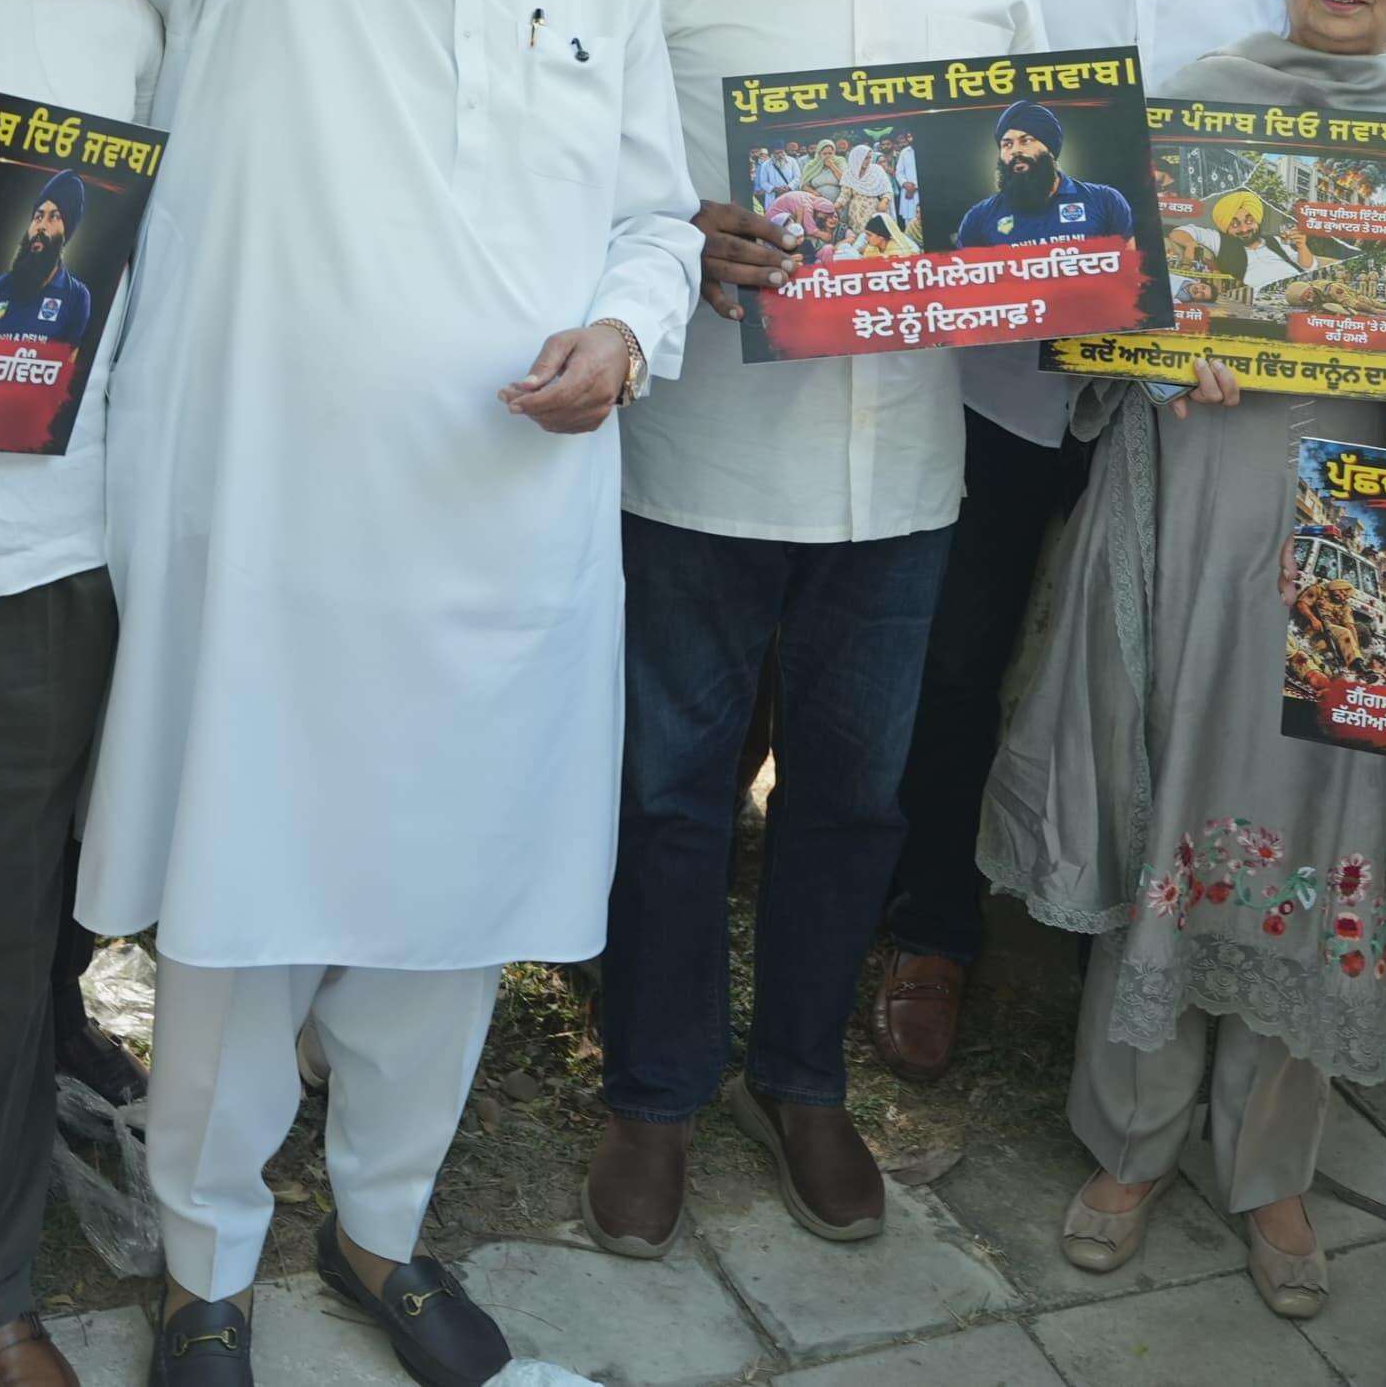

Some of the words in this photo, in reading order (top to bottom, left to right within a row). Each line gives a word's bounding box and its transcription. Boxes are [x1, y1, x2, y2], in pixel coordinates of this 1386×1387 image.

[732, 80, 827, 122] ਪੁੱਛਦਾ
[841, 70, 934, 106] ਪੰਜਾਬ
[945, 60, 1015, 101] ਦਿਓ
[1026, 58, 1136, 92] ਜਵਾਬ।
[23, 108, 80, 158] ਦਿਓ
[83, 132, 161, 177] ਜਵਾਬ।
[1183, 103, 1254, 134] ਪੰਜਾਬ
[1265, 108, 1319, 140] ਦਿਓ
[866, 261, 911, 292] ਕਦੋਂ
[914, 257, 1004, 289] ਮਿਲੇਗਾ
[1009, 248, 1120, 278] ਪਰਵਿੰਦਰ
[852, 307, 894, 338] ਝੋਟੇ
[897, 305, 922, 343] ਨੂੰ
[925, 302, 1028, 333] ਇਨਸਾਫ਼
[1080, 338, 1116, 362] ਕਦੋਂ
[1118, 342, 1191, 369] ਆਏਗਾ
[1256, 355, 1296, 378] ਵਿੱਚ
[1301, 361, 1361, 389] ਕਾਨੂੰਨ
